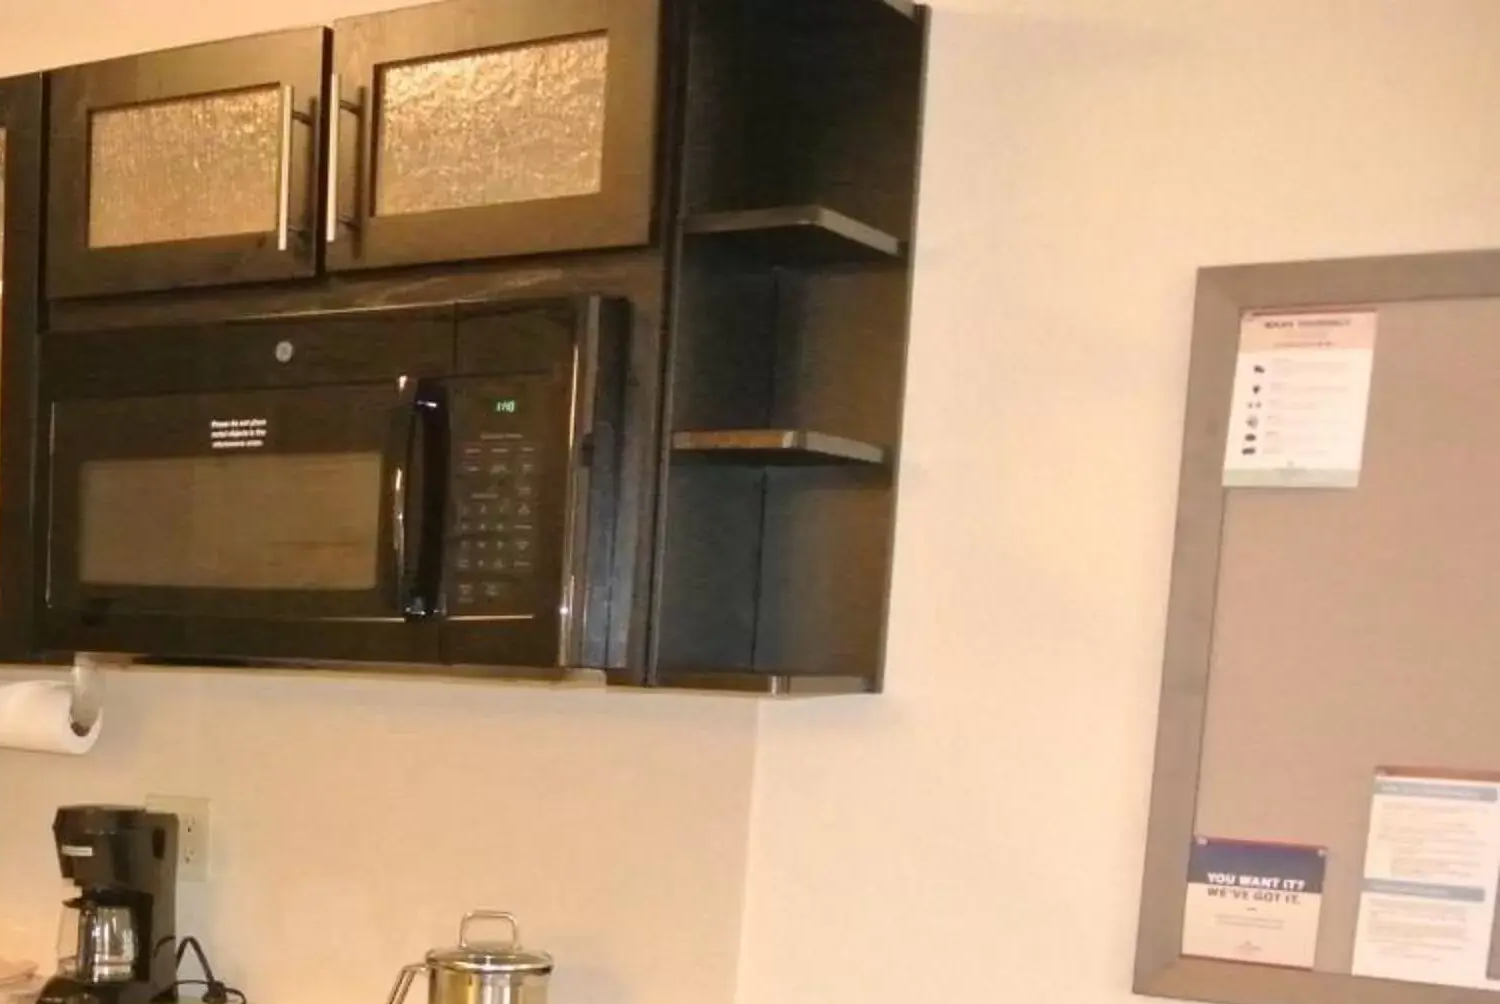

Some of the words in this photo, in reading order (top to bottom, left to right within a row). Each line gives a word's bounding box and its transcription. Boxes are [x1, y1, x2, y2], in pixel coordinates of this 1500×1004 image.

[1207, 872, 1236, 885] YOU
[1239, 875, 1280, 889] WANT
[1283, 879, 1306, 891] IT?
[1207, 887, 1249, 900] WE'VE
[1253, 889, 1280, 903] GOT
[1285, 894, 1301, 905] IT.
